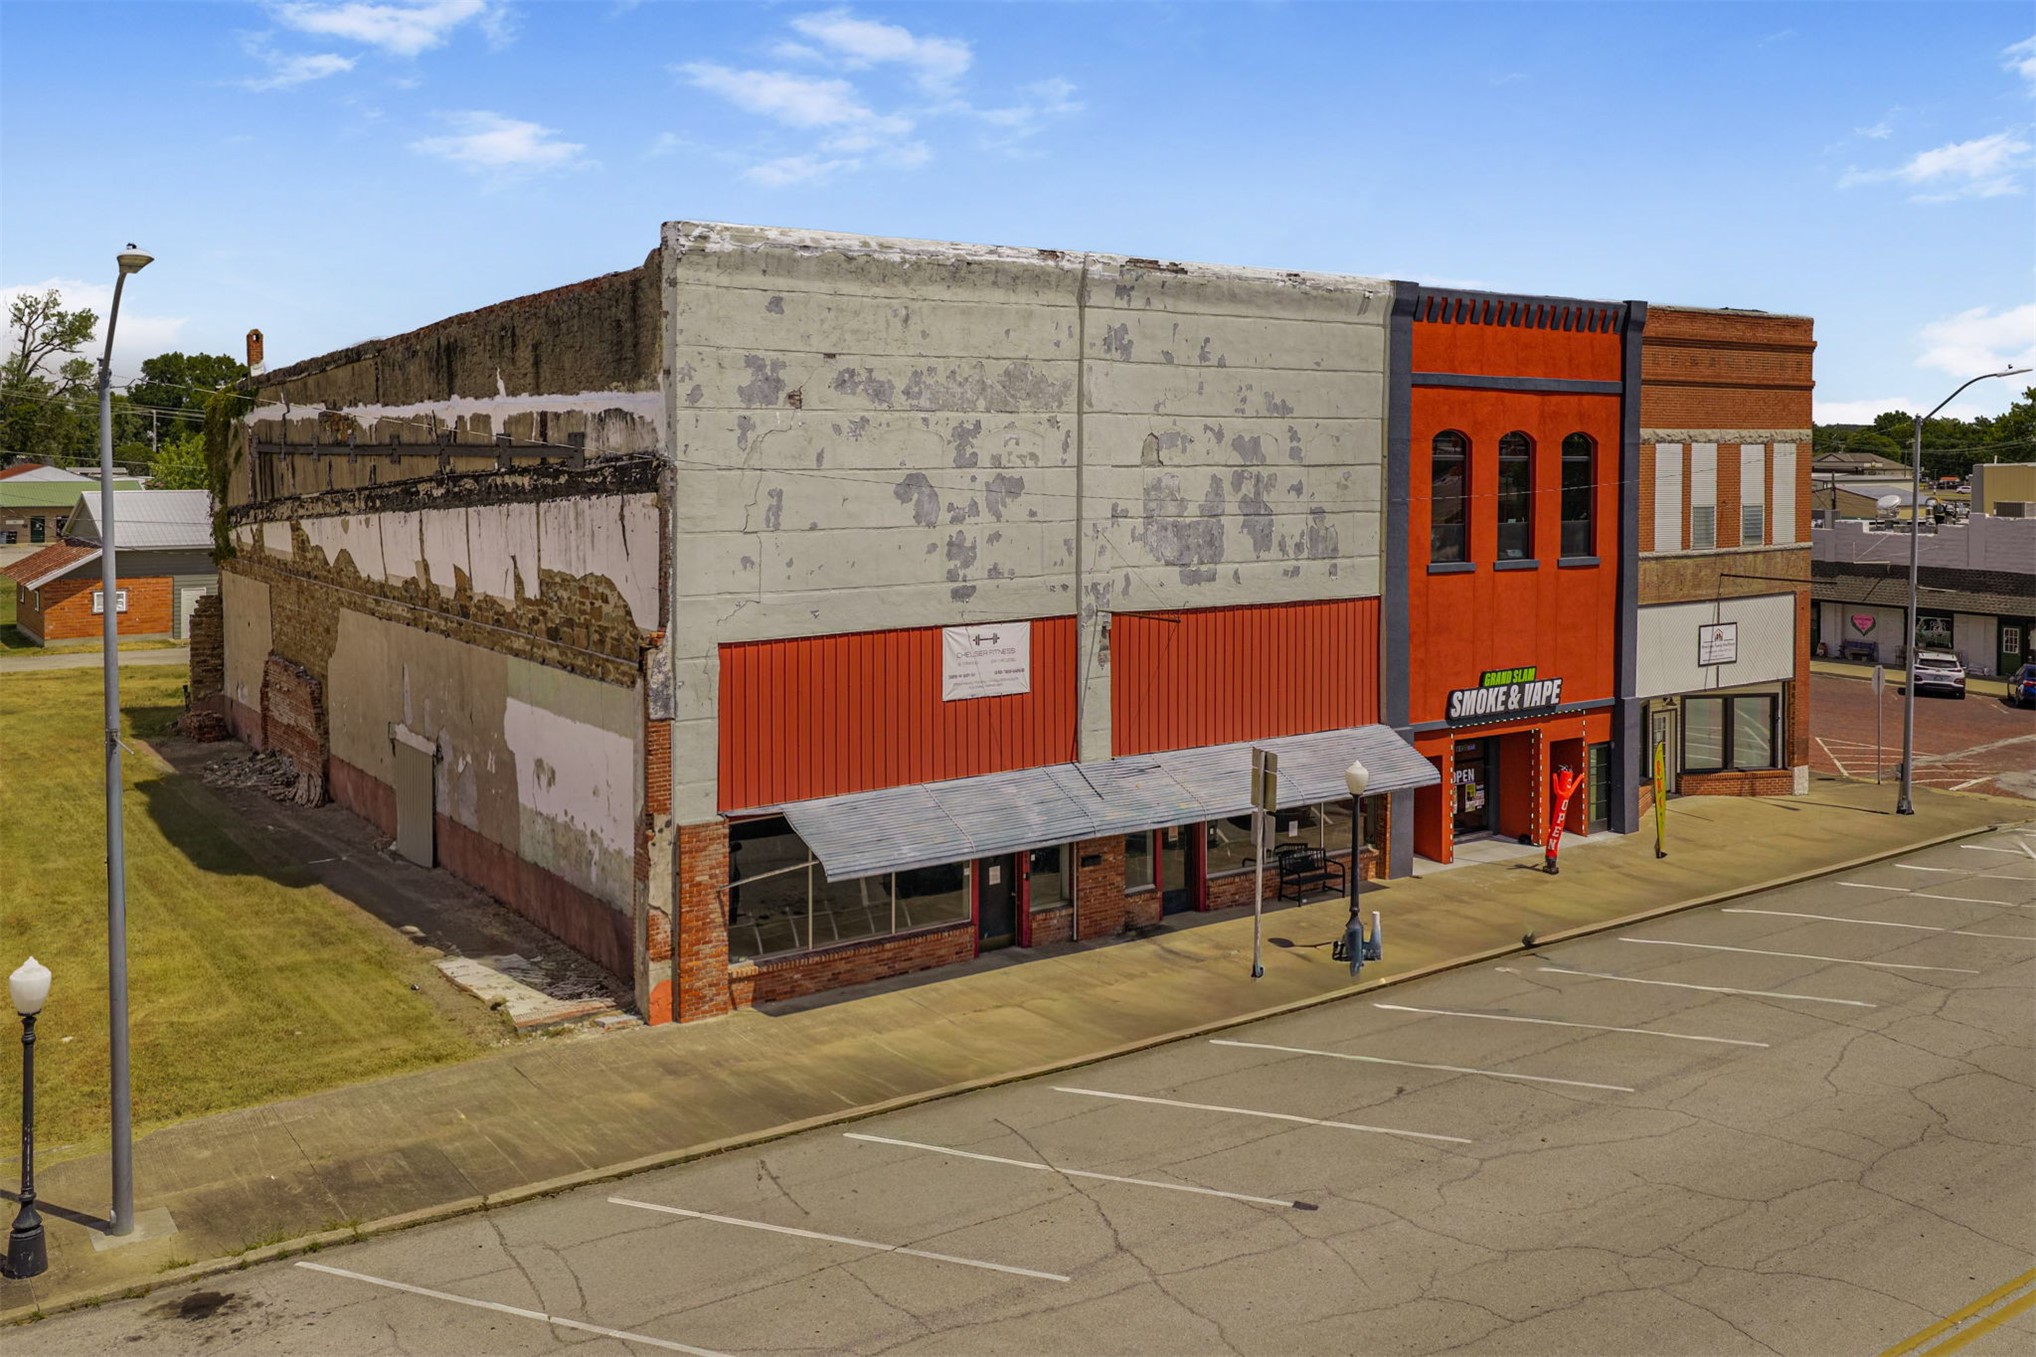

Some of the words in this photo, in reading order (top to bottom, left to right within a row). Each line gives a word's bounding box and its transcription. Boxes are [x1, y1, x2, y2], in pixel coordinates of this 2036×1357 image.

[957, 650, 988, 659] CHELSEA
[1484, 670, 1512, 687] GRAND
[1513, 667, 1536, 683] SLAM
[1451, 686, 1507, 717] SMOKE
[1507, 684, 1522, 710] &
[1523, 679, 1561, 708] VAPE
[1548, 799, 1569, 851] OPEN
